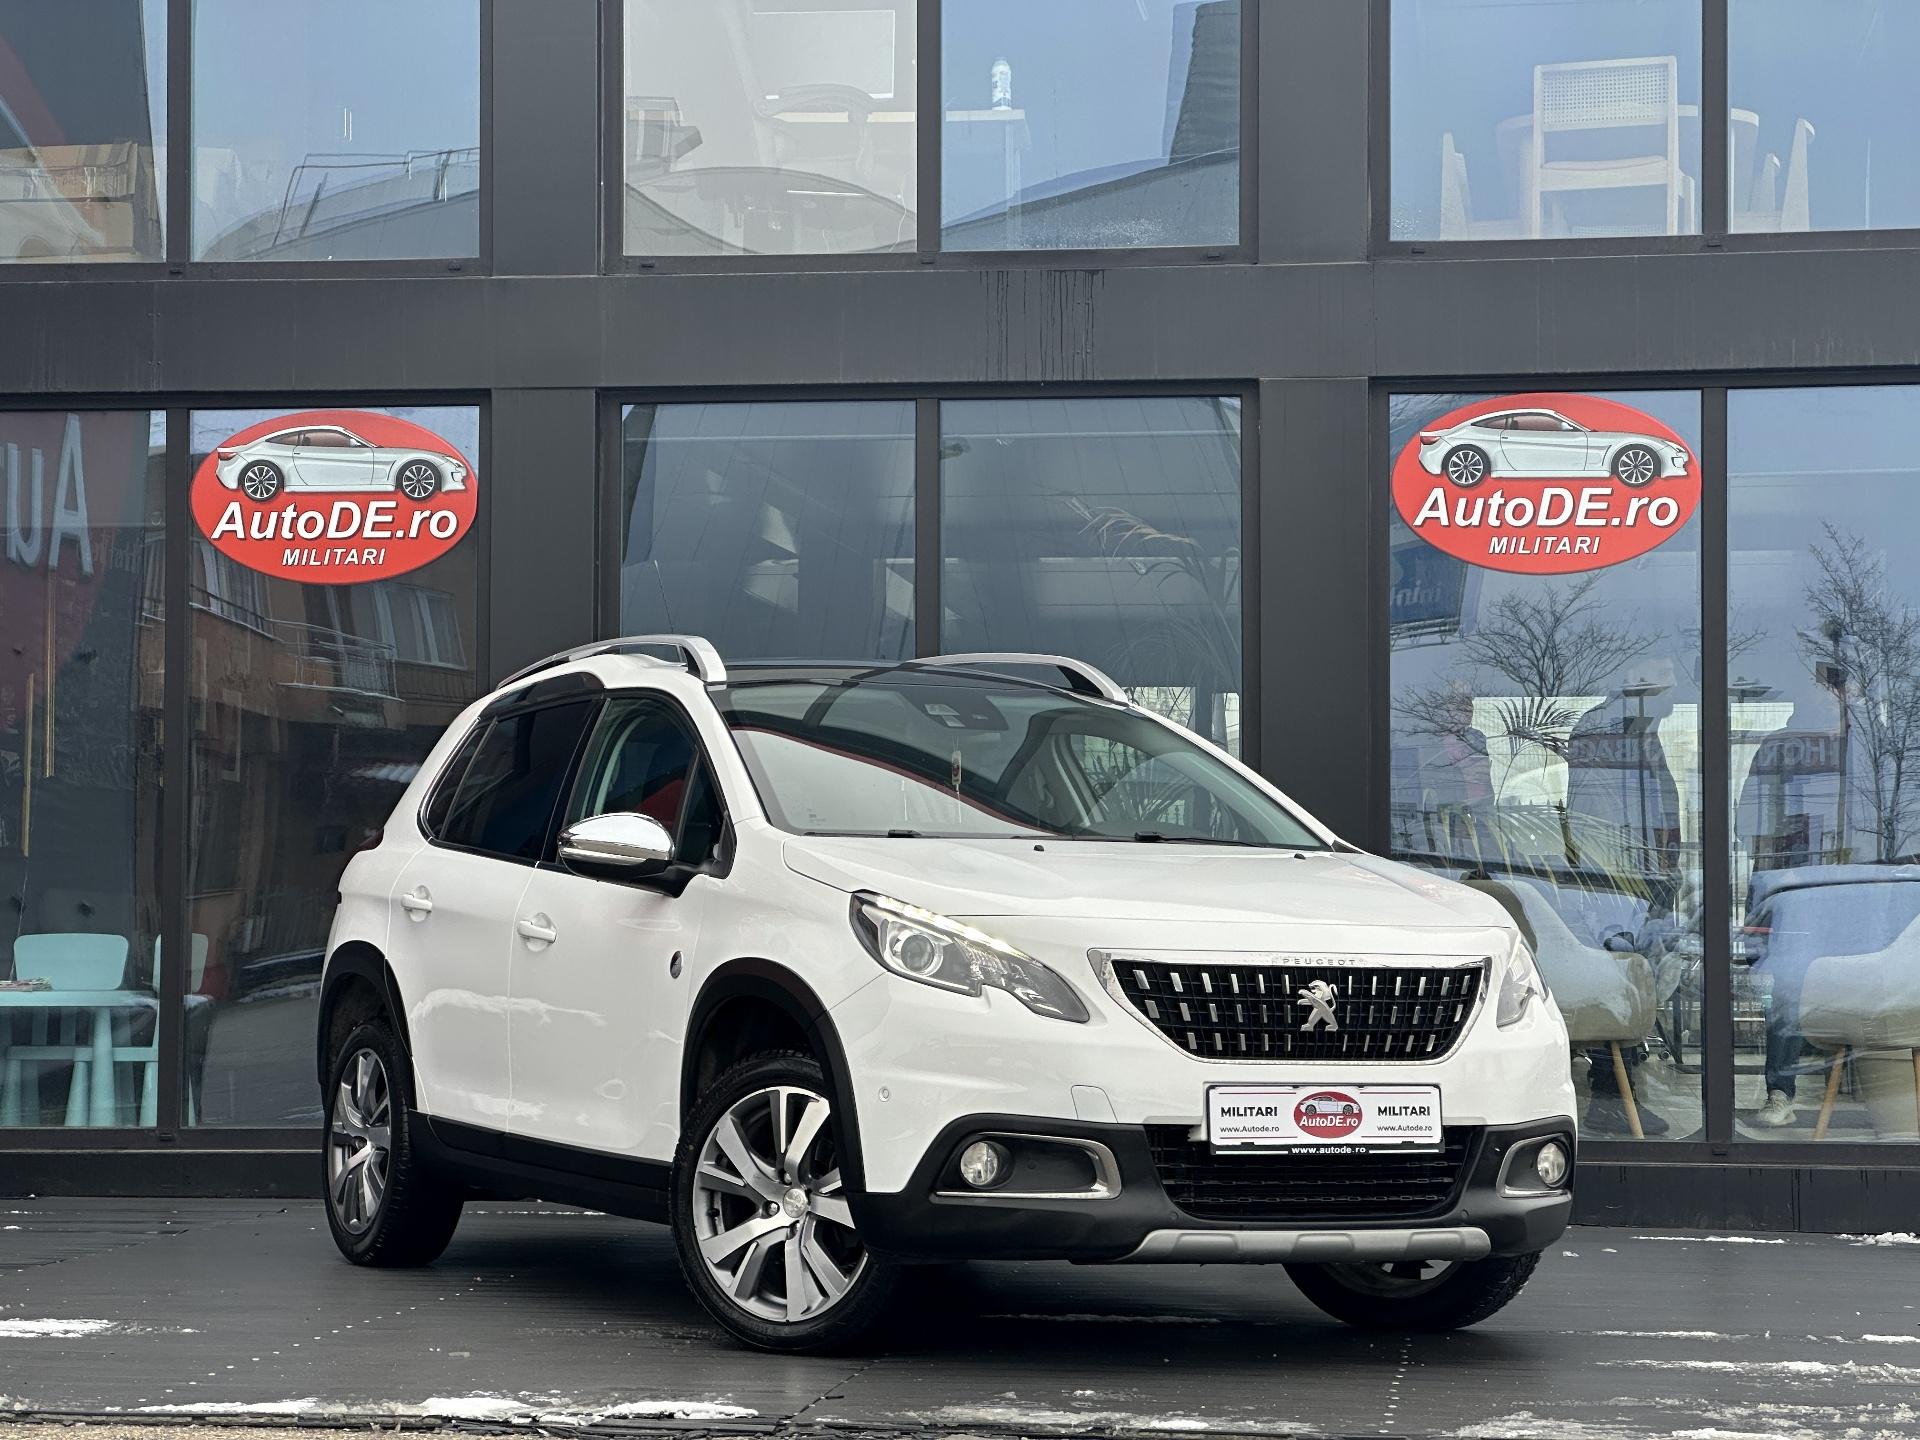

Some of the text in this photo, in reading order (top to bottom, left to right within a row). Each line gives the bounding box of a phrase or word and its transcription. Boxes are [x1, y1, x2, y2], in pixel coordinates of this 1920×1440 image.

[1413, 486, 1680, 529] AutoDE.ro
[211, 500, 458, 541] AutoDE.ro
[1487, 535, 1601, 555] MILITARI
[281, 547, 387, 567] MILITARI
[1282, 957, 1356, 966] PEUGEOT
[1220, 1106, 1278, 1118] MILITARI
[1377, 1106, 1431, 1117] MILITARI
[1299, 1115, 1359, 1128] AutoDE.ro
[1219, 1125, 1280, 1133] www.Autode.ro
[1376, 1124, 1433, 1132] www.Autode.ro
[1291, 1146, 1367, 1155] www.autode.ro
